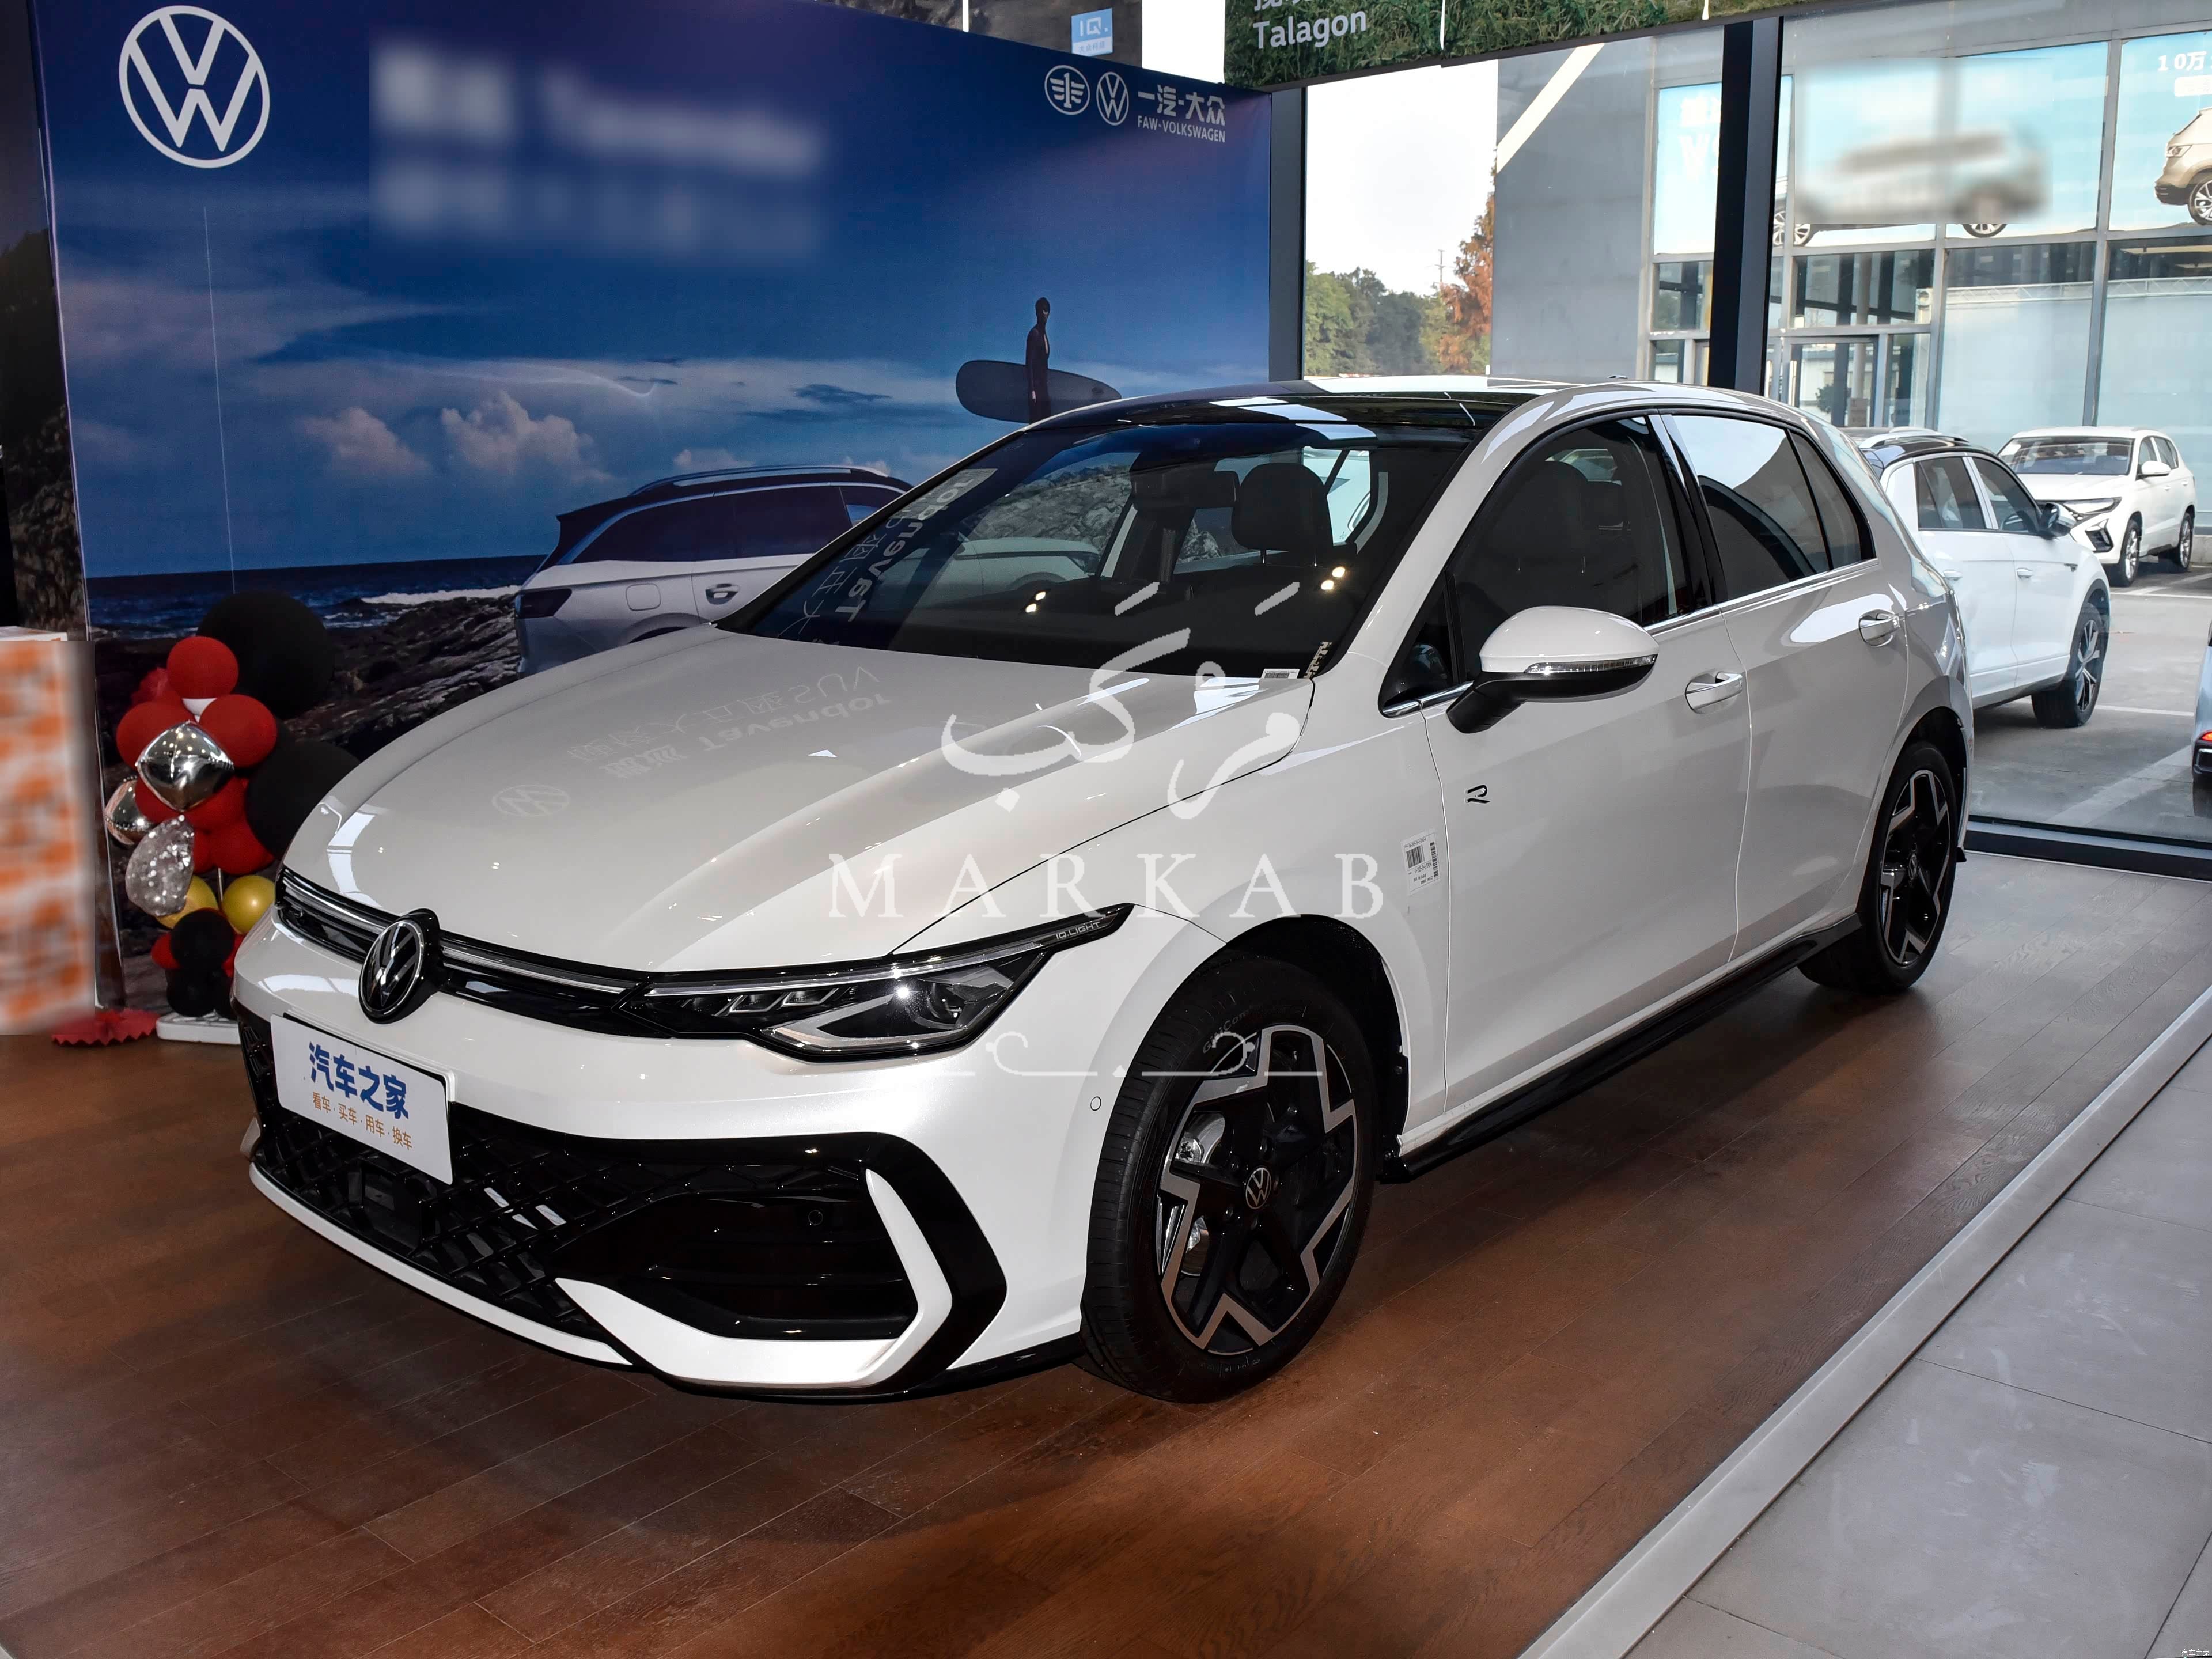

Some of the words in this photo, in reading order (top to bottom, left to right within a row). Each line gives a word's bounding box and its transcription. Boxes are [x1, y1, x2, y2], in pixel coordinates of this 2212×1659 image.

[1253, 10, 1366, 49] Talagon
[1138, 115, 1225, 143] FAW-VOLKSWAGEN
[1055, 921, 1100, 940] IQ.LIGHT
[309, 1041, 409, 1119] 汽车之家
